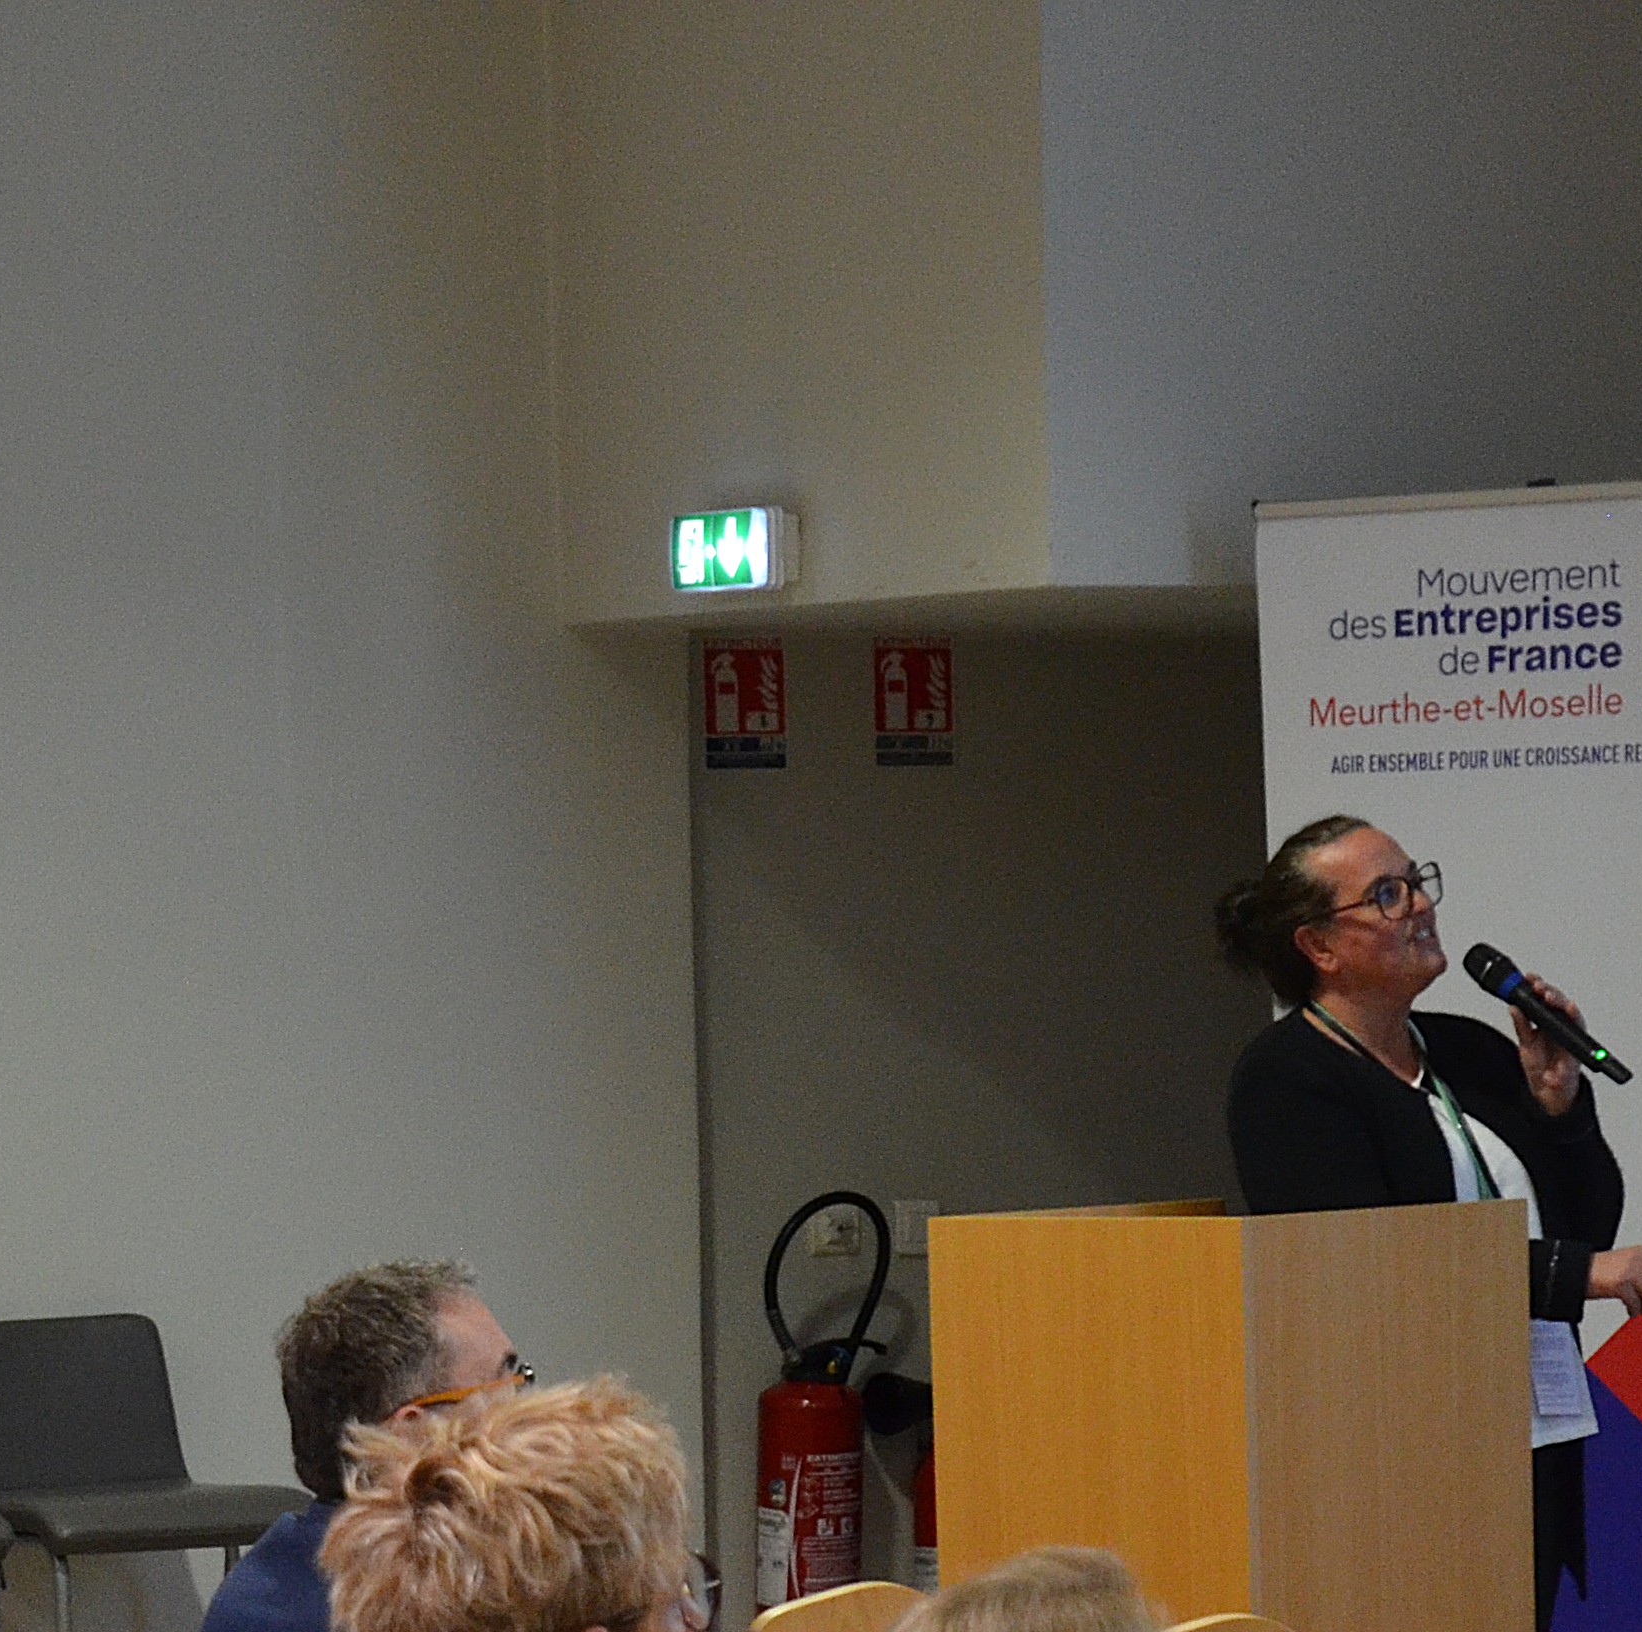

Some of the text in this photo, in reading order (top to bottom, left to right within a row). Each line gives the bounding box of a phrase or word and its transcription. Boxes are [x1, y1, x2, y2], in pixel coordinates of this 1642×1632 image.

[1418, 560, 1621, 597] Mouvement
[1329, 596, 1623, 640] des Entreprises
[1439, 641, 1623, 675] de France
[1310, 684, 1624, 727] Meurthe-et-Moselle
[1332, 754, 1364, 774] AGIR
[1369, 752, 1443, 771] ENSEMBLE
[1449, 750, 1487, 769] POUR
[1492, 749, 1521, 768] UNE
[1526, 745, 1620, 767] CROISSANCE
